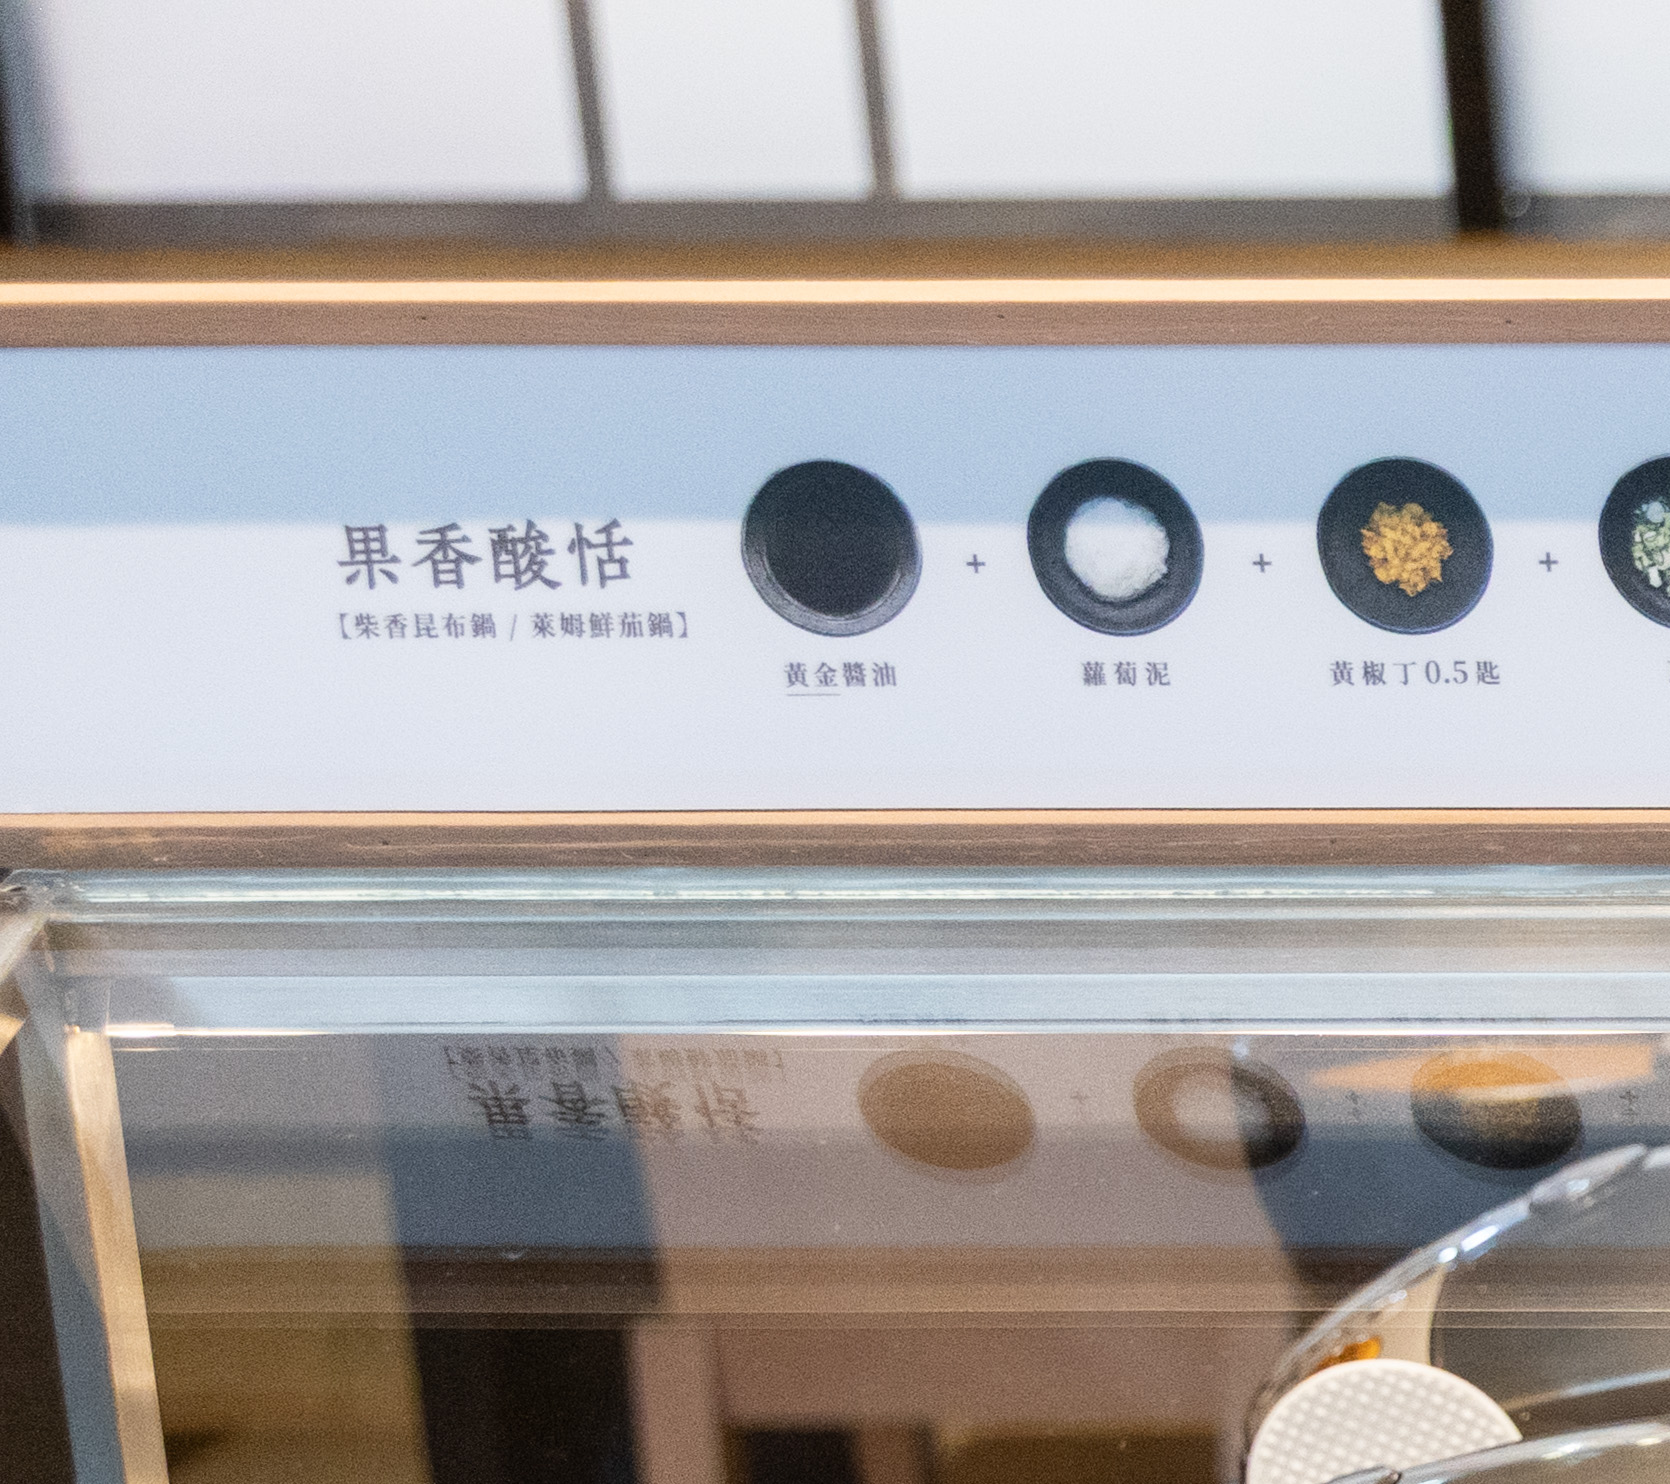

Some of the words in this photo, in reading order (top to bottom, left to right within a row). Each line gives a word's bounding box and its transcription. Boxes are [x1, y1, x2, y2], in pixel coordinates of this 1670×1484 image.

[337, 518, 634, 591] 果香酸恬
[785, 661, 897, 687] 黃金醬油
[1082, 660, 1171, 687] 蘿蔔泥
